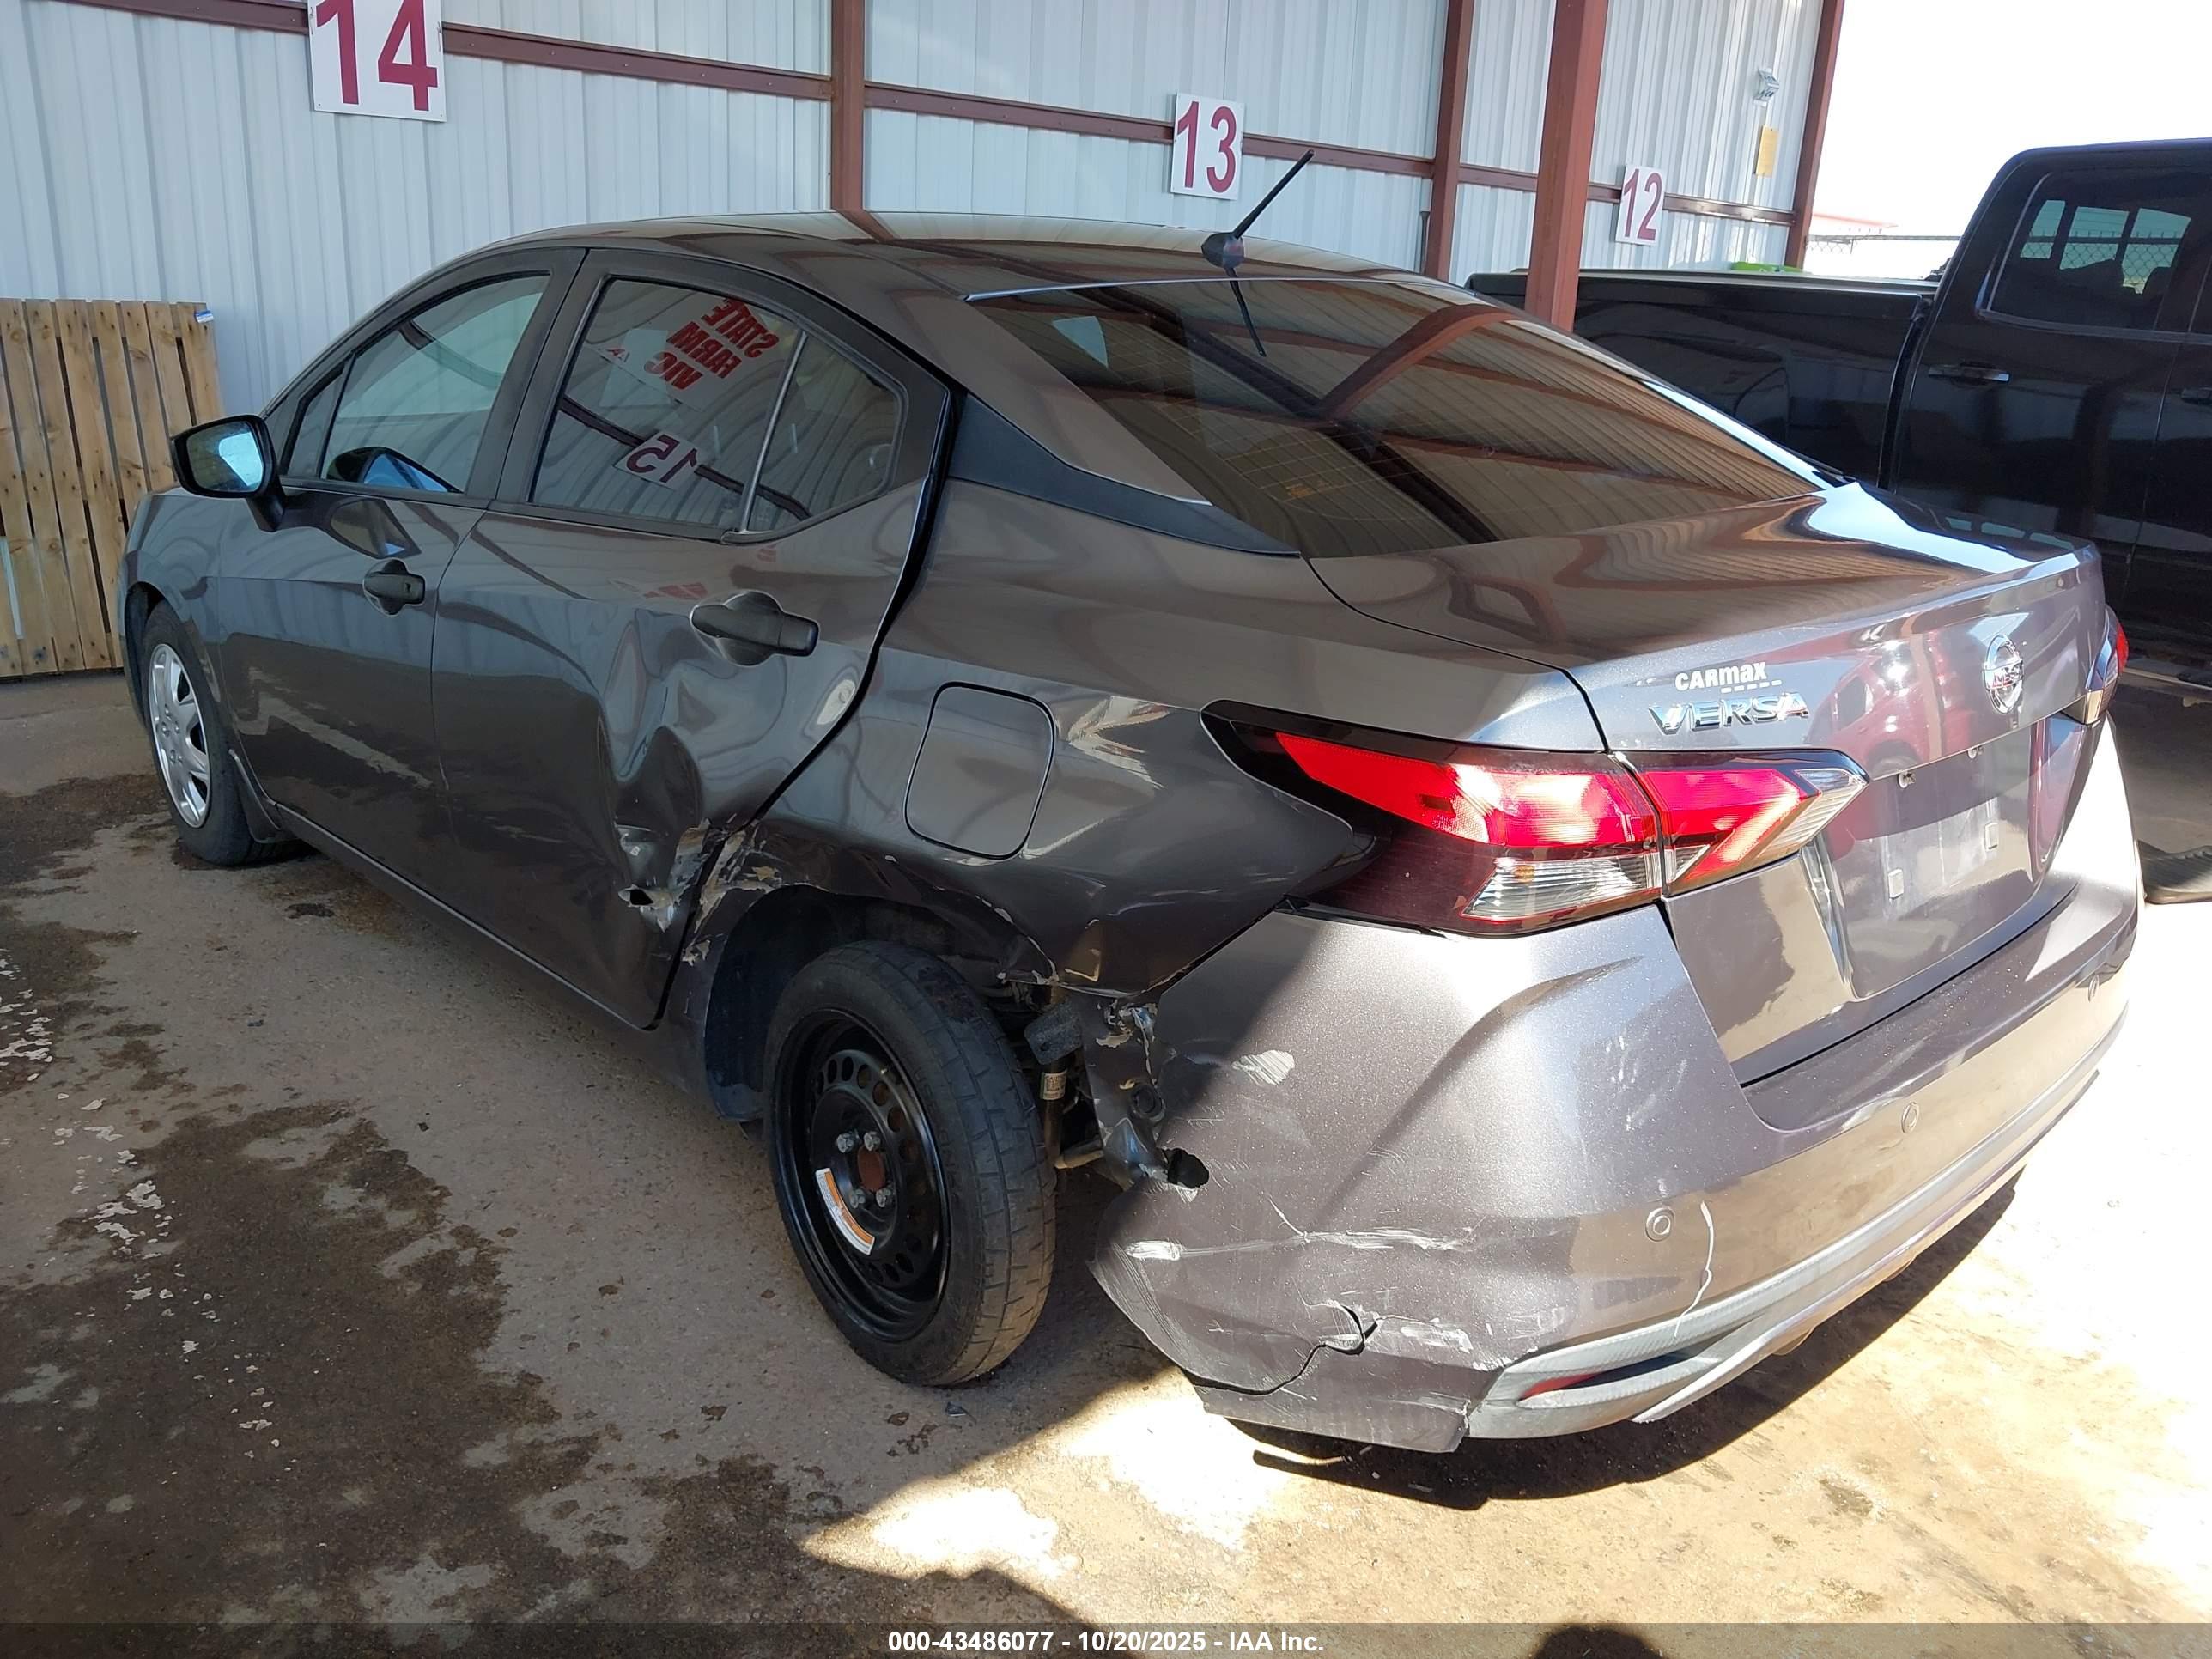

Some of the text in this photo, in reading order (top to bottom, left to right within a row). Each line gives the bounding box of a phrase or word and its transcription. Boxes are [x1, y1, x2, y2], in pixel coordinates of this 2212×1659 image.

[316, 0, 438, 111] 14
[1177, 101, 1237, 193] 13
[1620, 168, 1663, 241] 12
[1648, 691, 1809, 735] VERSA
